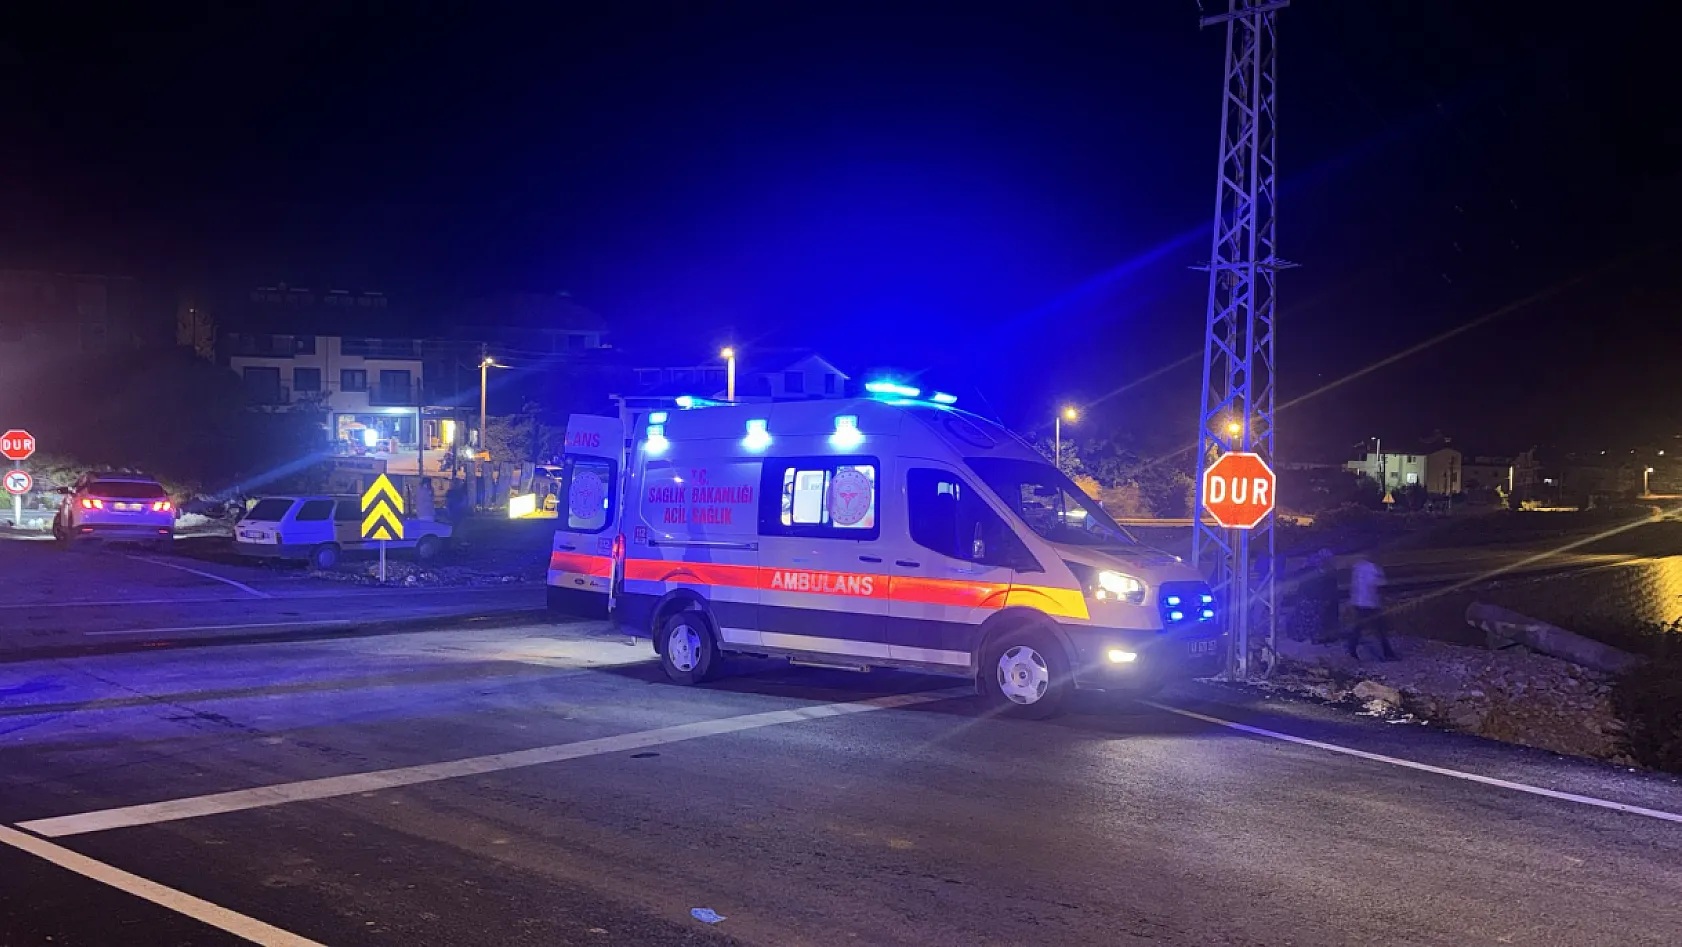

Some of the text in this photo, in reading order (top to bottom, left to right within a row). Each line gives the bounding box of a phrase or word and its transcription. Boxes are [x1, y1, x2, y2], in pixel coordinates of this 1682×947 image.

[3, 438, 32, 451] DUR
[1210, 475, 1269, 506] DUR
[691, 504, 732, 524] SAĞLIK
[771, 570, 874, 596] AMBULANS
